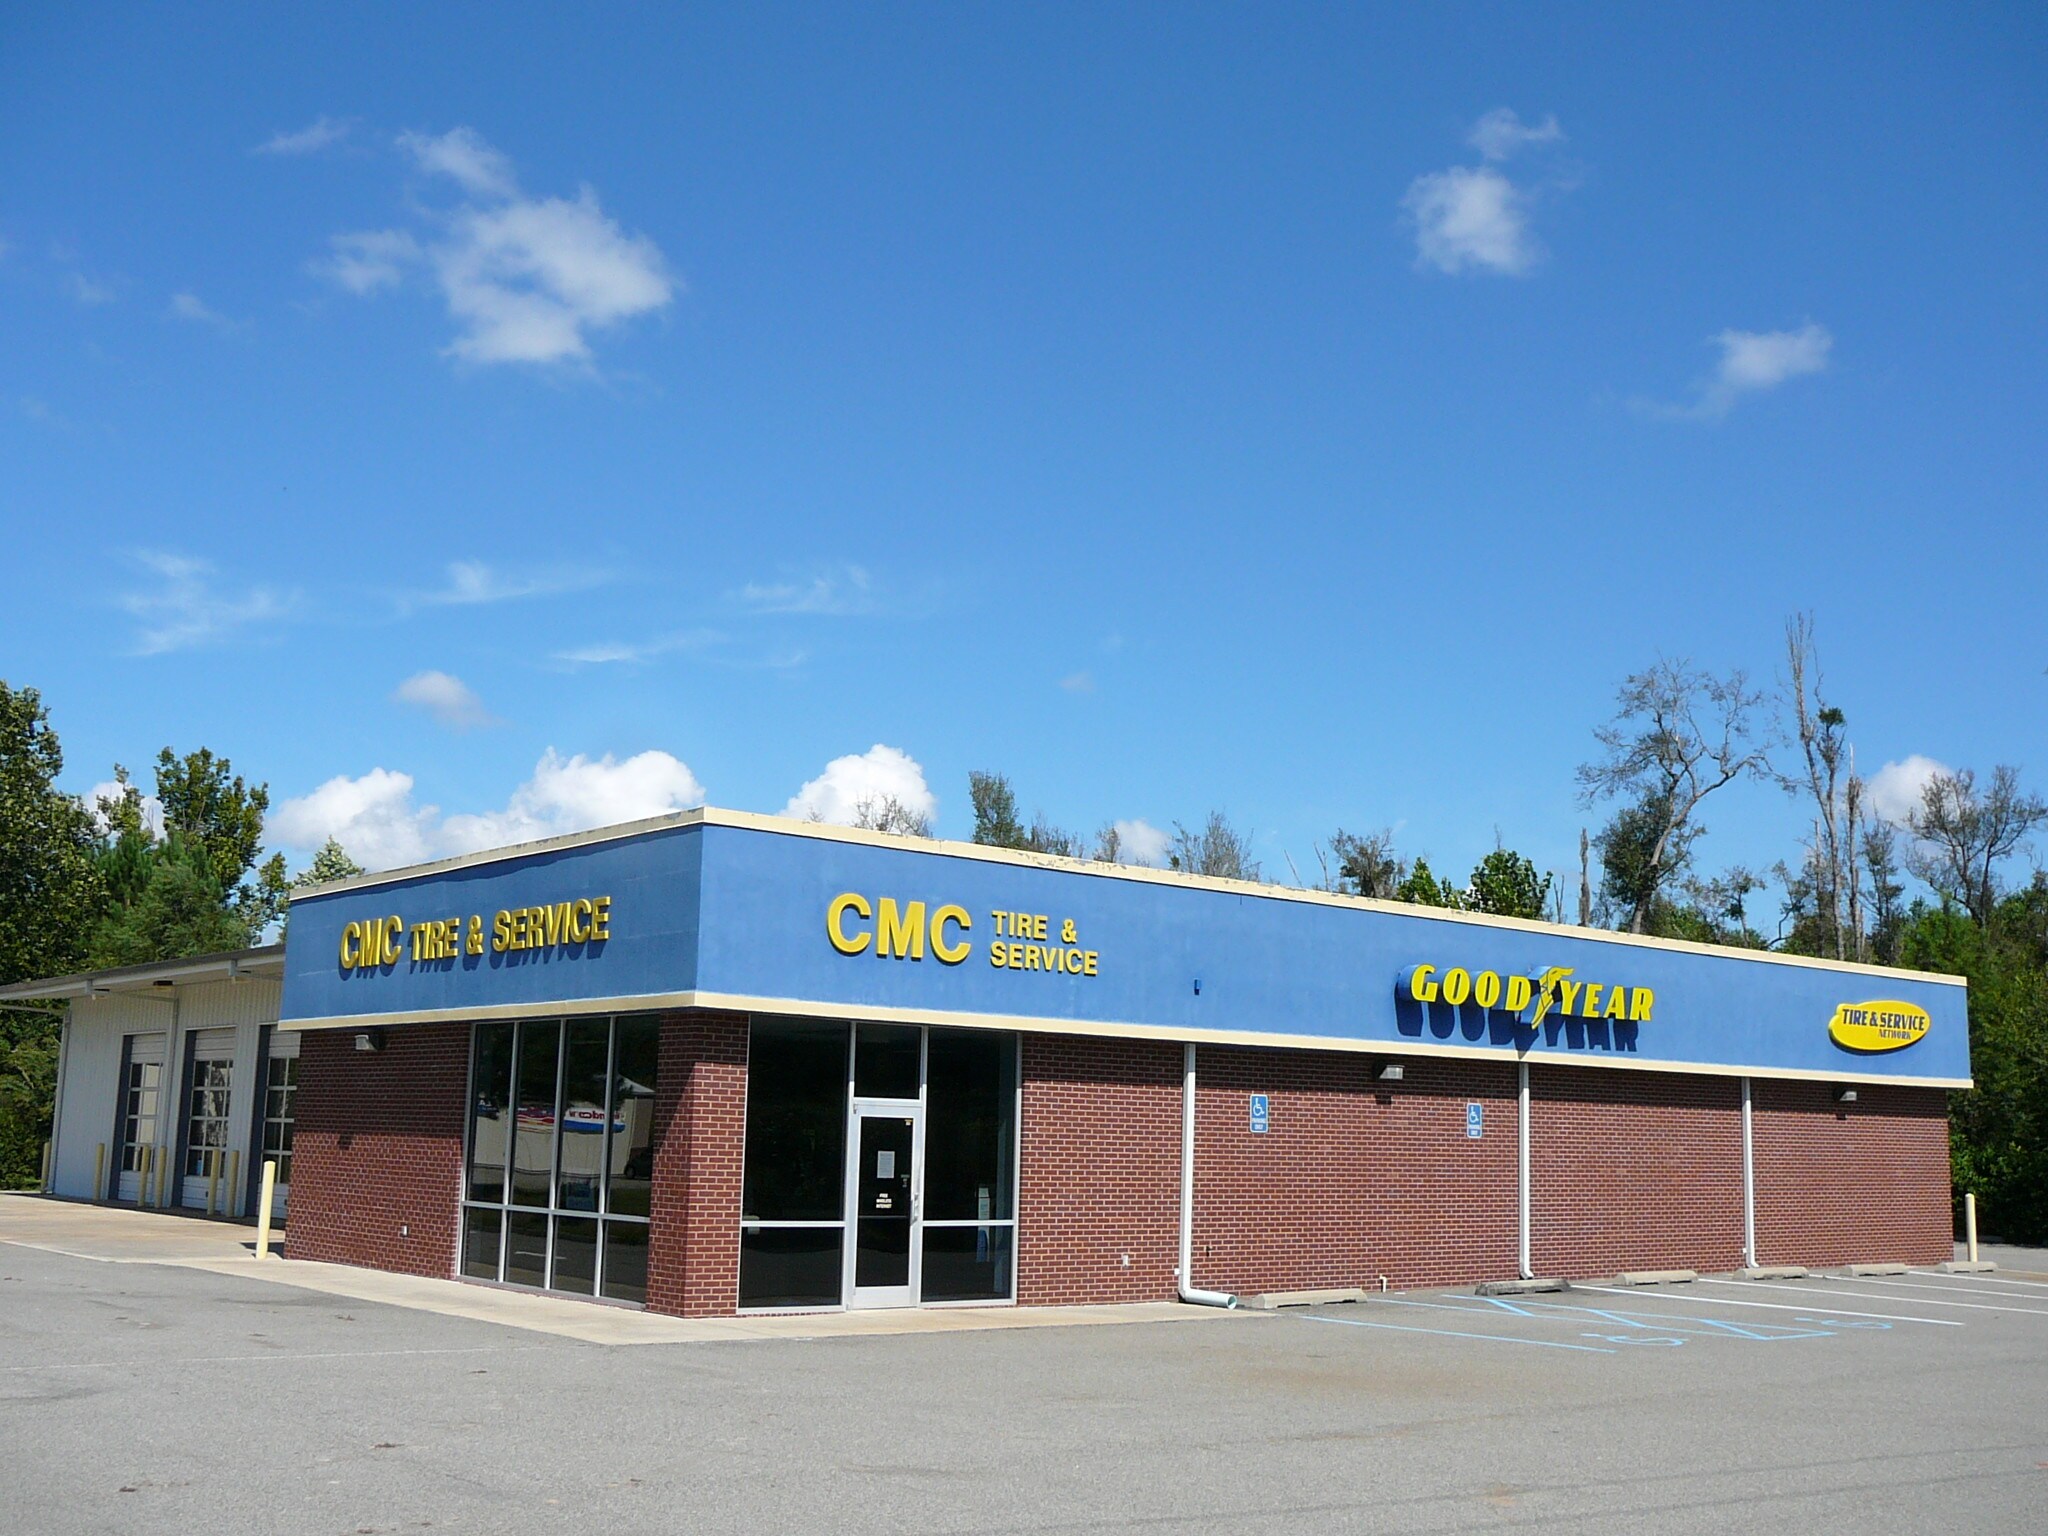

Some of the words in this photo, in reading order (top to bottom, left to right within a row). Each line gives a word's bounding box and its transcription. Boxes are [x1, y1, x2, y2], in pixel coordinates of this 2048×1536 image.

[340, 915, 402, 970] CMC
[410, 918, 460, 961] TIRE
[466, 915, 484, 955] &
[492, 895, 611, 951] SERVICE
[827, 893, 972, 963] CMC
[992, 910, 1048, 940] TIRE
[1061, 918, 1078, 943] &
[990, 942, 1099, 975] SERVICE
[1411, 964, 1655, 1022] GOODYEAR
[1842, 1008, 1868, 1026] TIRE
[1869, 1011, 1879, 1027] &
[1880, 1012, 1926, 1031] SERVICE
[1878, 1028, 1912, 1040] NETWORK
